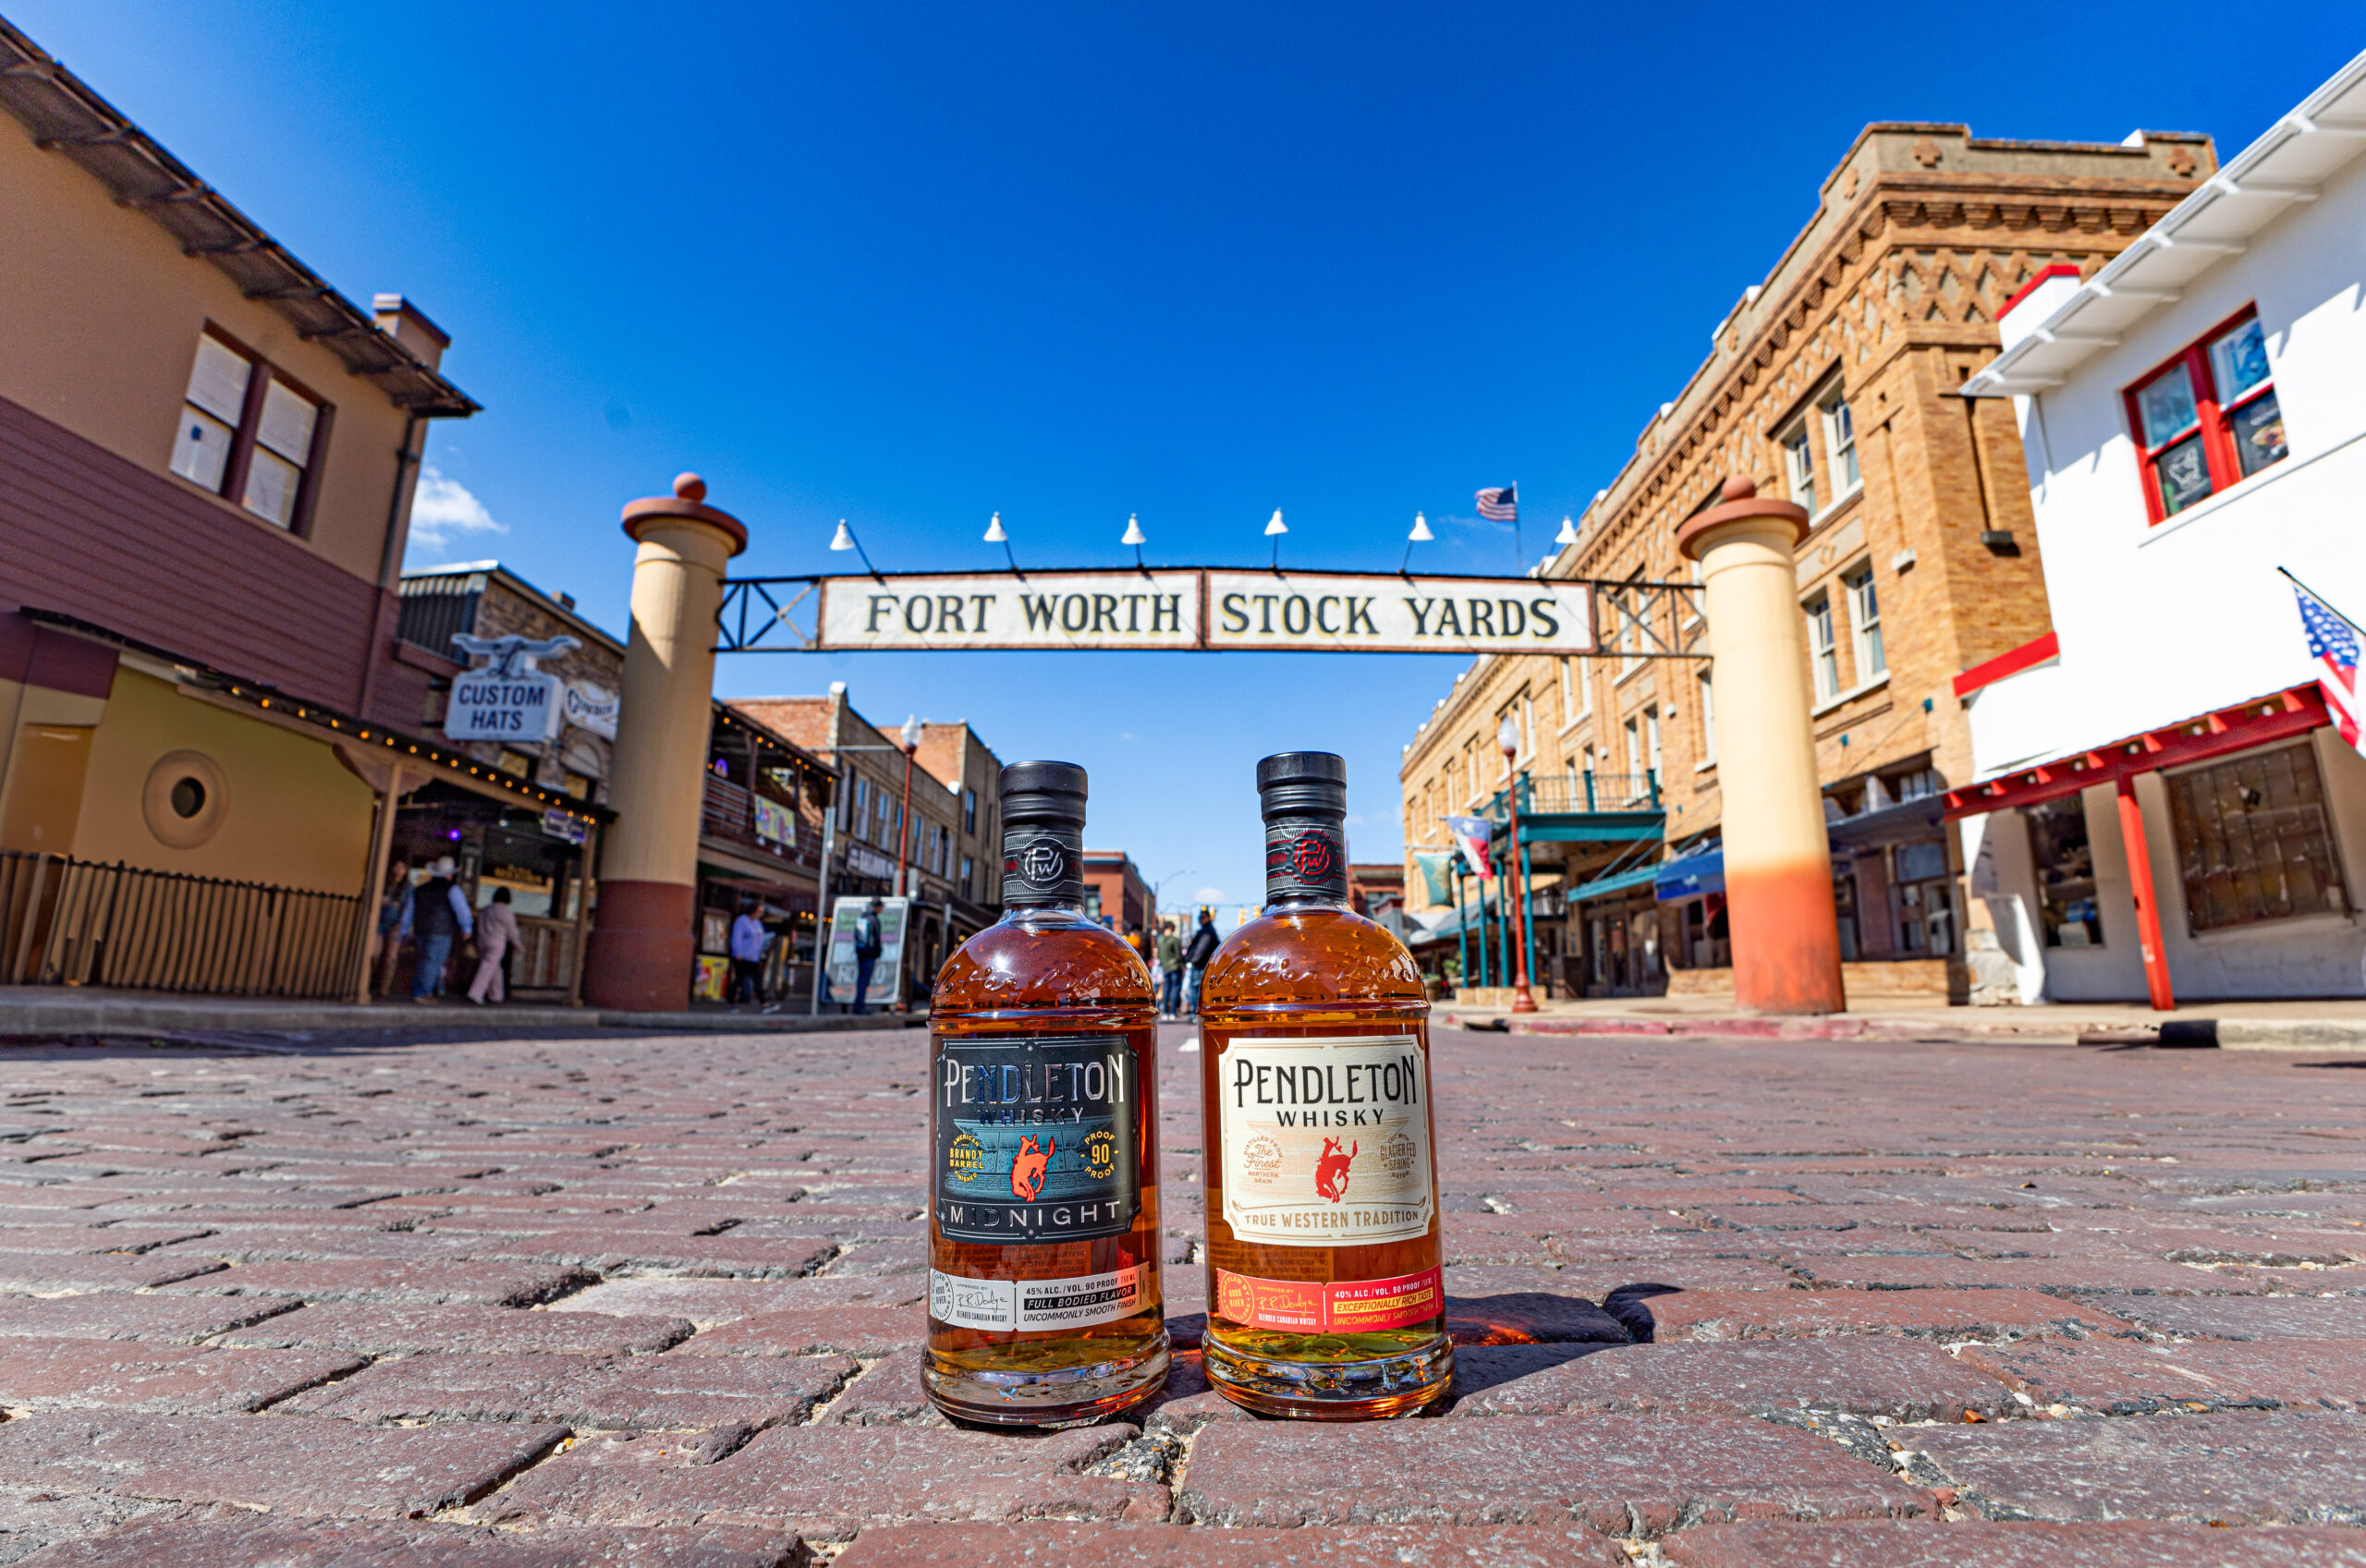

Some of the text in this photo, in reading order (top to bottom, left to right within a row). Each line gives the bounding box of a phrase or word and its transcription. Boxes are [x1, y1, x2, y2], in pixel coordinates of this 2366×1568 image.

[864, 592, 1560, 638] FORT WORTH STOCK YARDS
[457, 684, 545, 707] CUSTOM
[470, 710, 523, 731] HATS
[945, 1054, 1125, 1107] PENDLETON
[1233, 1054, 1418, 1108] PENDLETON
[977, 1107, 1084, 1127] WHISKY
[1276, 1108, 1384, 1127] WHISKY
[954, 1134, 980, 1147] AMERICAN
[1084, 1130, 1116, 1145] PROOF
[949, 1148, 983, 1161] BRANDY
[1092, 1143, 1109, 1164] 90
[1255, 1143, 1274, 1157] The
[1380, 1143, 1406, 1161] GLACIER
[949, 1159, 984, 1169] BARREL
[1243, 1152, 1282, 1169] Finest
[1388, 1157, 1410, 1171] SPRING
[954, 1170, 977, 1182] FINISHED
[1084, 1162, 1115, 1179] PROOF
[950, 1200, 1120, 1227] MIDNIGHT
[1244, 1210, 1419, 1228] TRUE WESTERN TRADITION
[1026, 1287, 1043, 1295] 45%
[1085, 1282, 1095, 1291] 90
[1096, 1277, 1118, 1289] PROOF
[1335, 1290, 1352, 1298] 40%
[1402, 1281, 1421, 1292] PROOF
[1027, 1298, 1054, 1309] FULL
[1057, 1295, 1097, 1307] BODIED
[1100, 1285, 1132, 1302] FLAVOR
[1336, 1288, 1433, 1313] EXCEPTIONALLY RICH TASTE
[1023, 1297, 1137, 1322] UNCOMMONLY SMOOTH FINISH
[1334, 1312, 1392, 1326] UNCOMMONLY
[1393, 1307, 1420, 1321] SMOOTH
